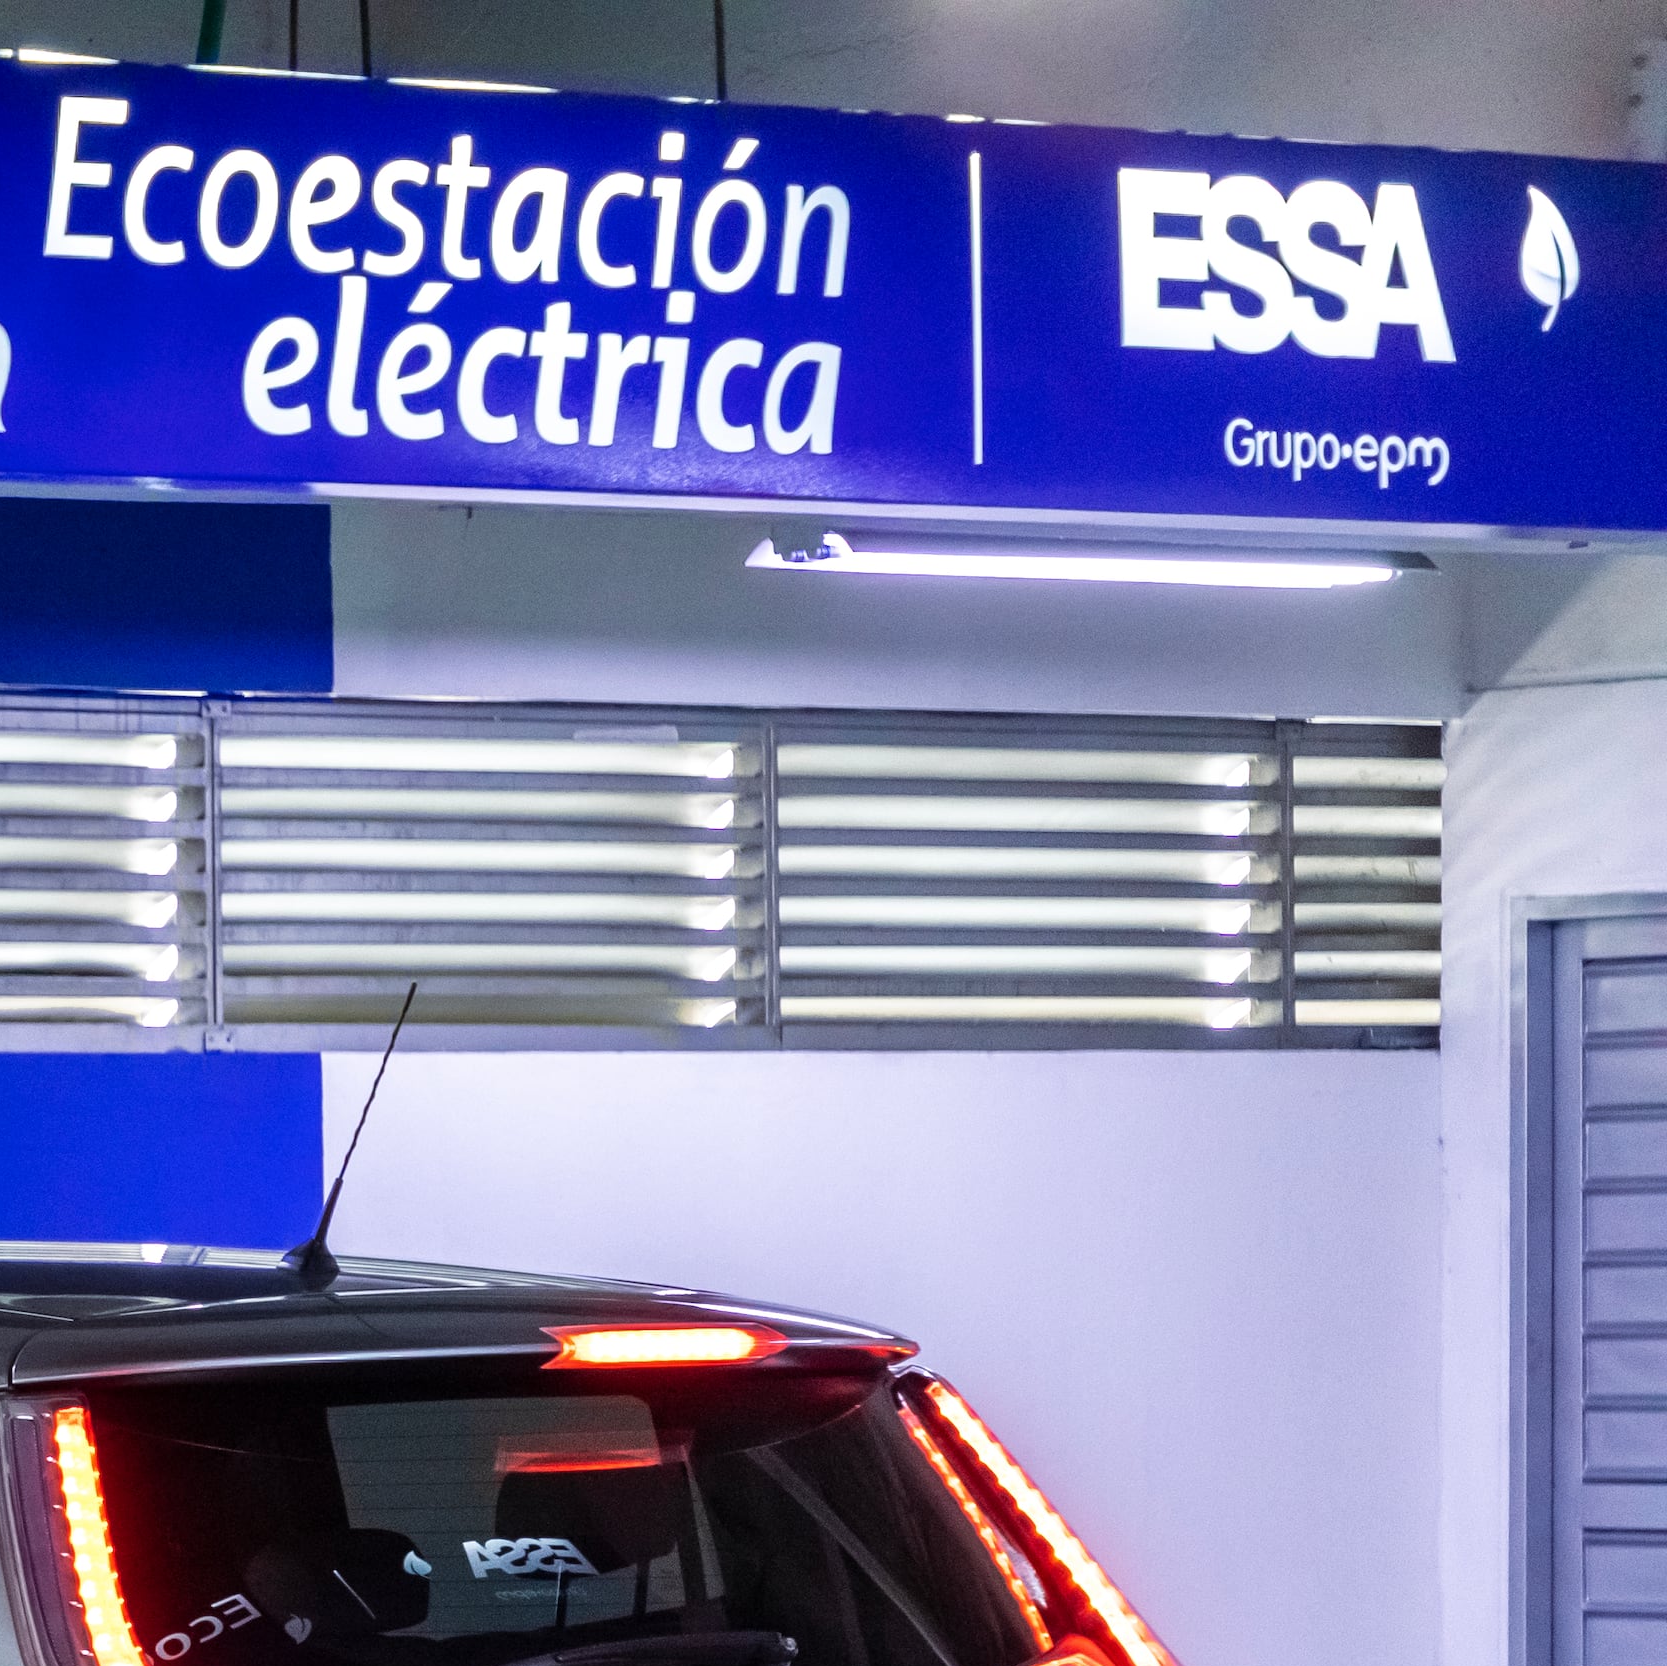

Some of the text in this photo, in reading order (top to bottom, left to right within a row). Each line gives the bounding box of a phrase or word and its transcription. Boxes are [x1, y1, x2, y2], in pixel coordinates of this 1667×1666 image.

[43, 96, 851, 298] Ecoestación
[1117, 168, 1456, 362] ESSA
[243, 275, 844, 456] eléctrica
